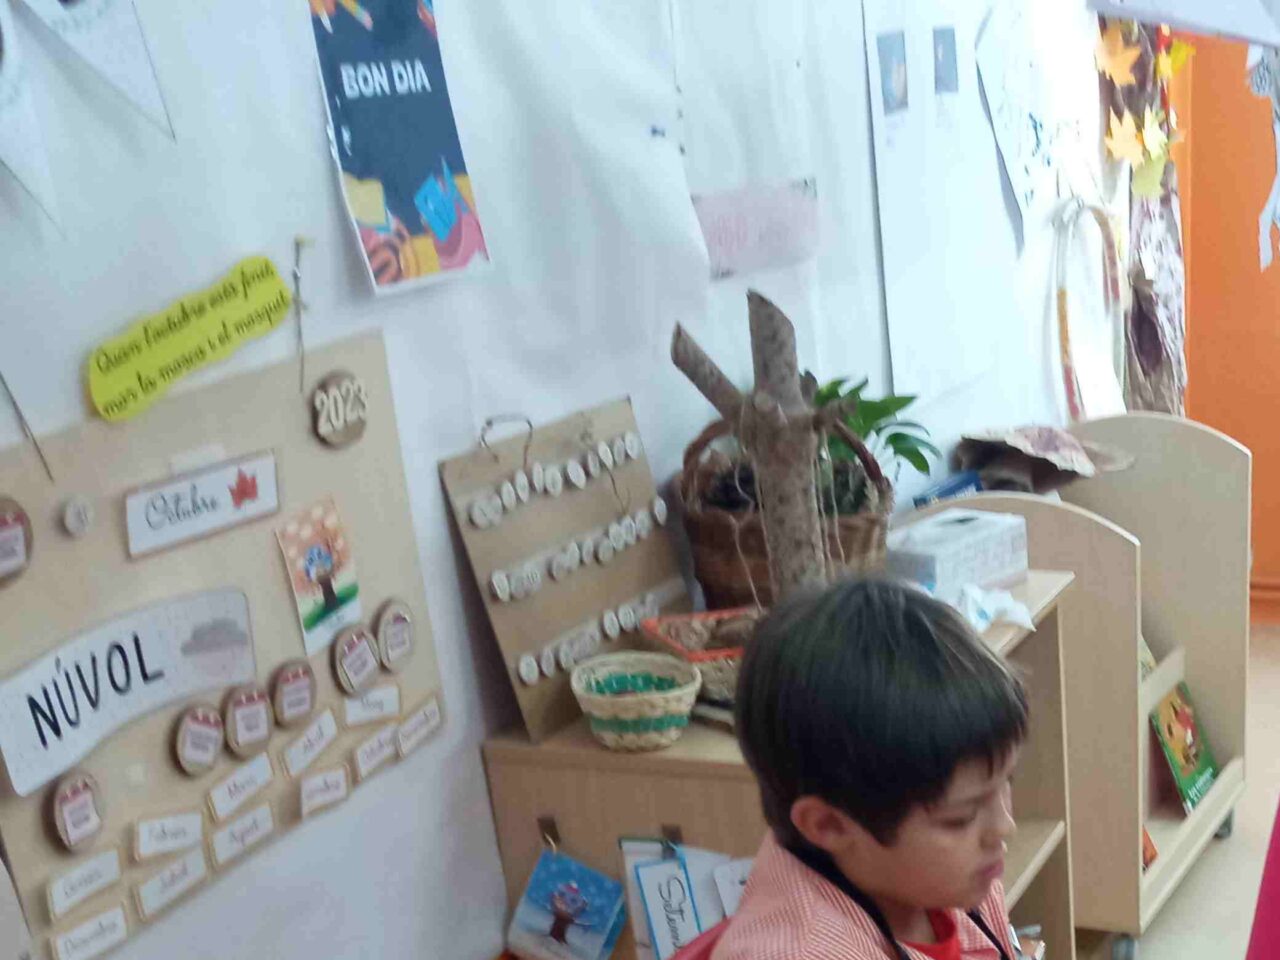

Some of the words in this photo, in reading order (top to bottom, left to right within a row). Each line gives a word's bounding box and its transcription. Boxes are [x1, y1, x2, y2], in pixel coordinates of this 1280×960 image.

[340, 61, 391, 100] BON
[391, 58, 432, 95] DIA
[315, 378, 369, 435] 2023
[26, 631, 166, 750] NÚVOL
